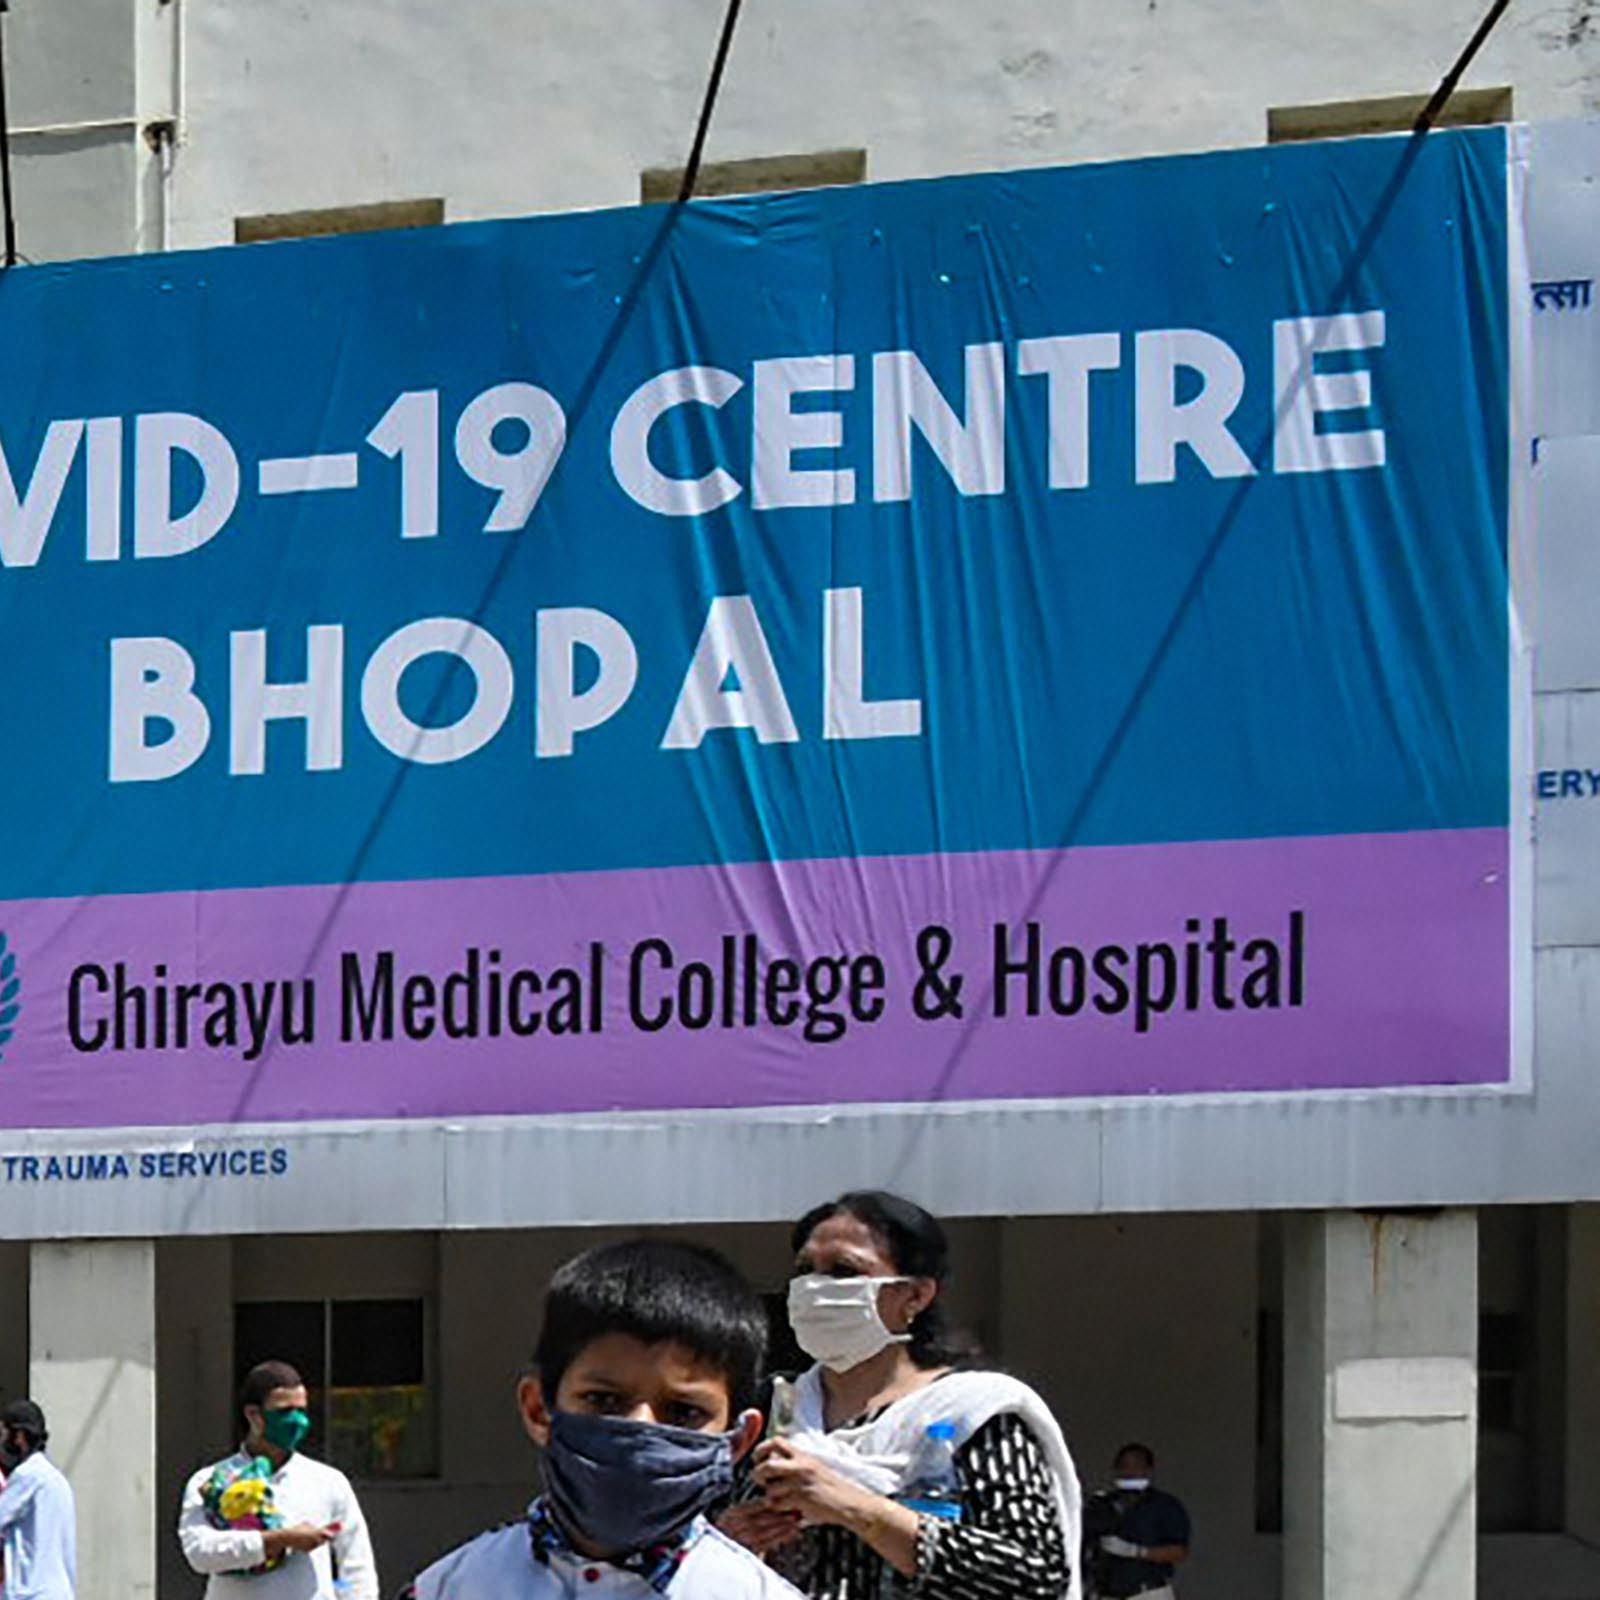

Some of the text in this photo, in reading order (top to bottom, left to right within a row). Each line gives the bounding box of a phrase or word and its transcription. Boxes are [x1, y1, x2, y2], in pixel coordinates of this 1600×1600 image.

[609, 309, 1387, 517] CENTRE
[108, 586, 923, 784] BHOPAL
[65, 908, 1306, 1062] Chirayu Medical College & Hospital
[6, 1154, 129, 1183] TRAUMA
[139, 1148, 289, 1180] SERVICES
